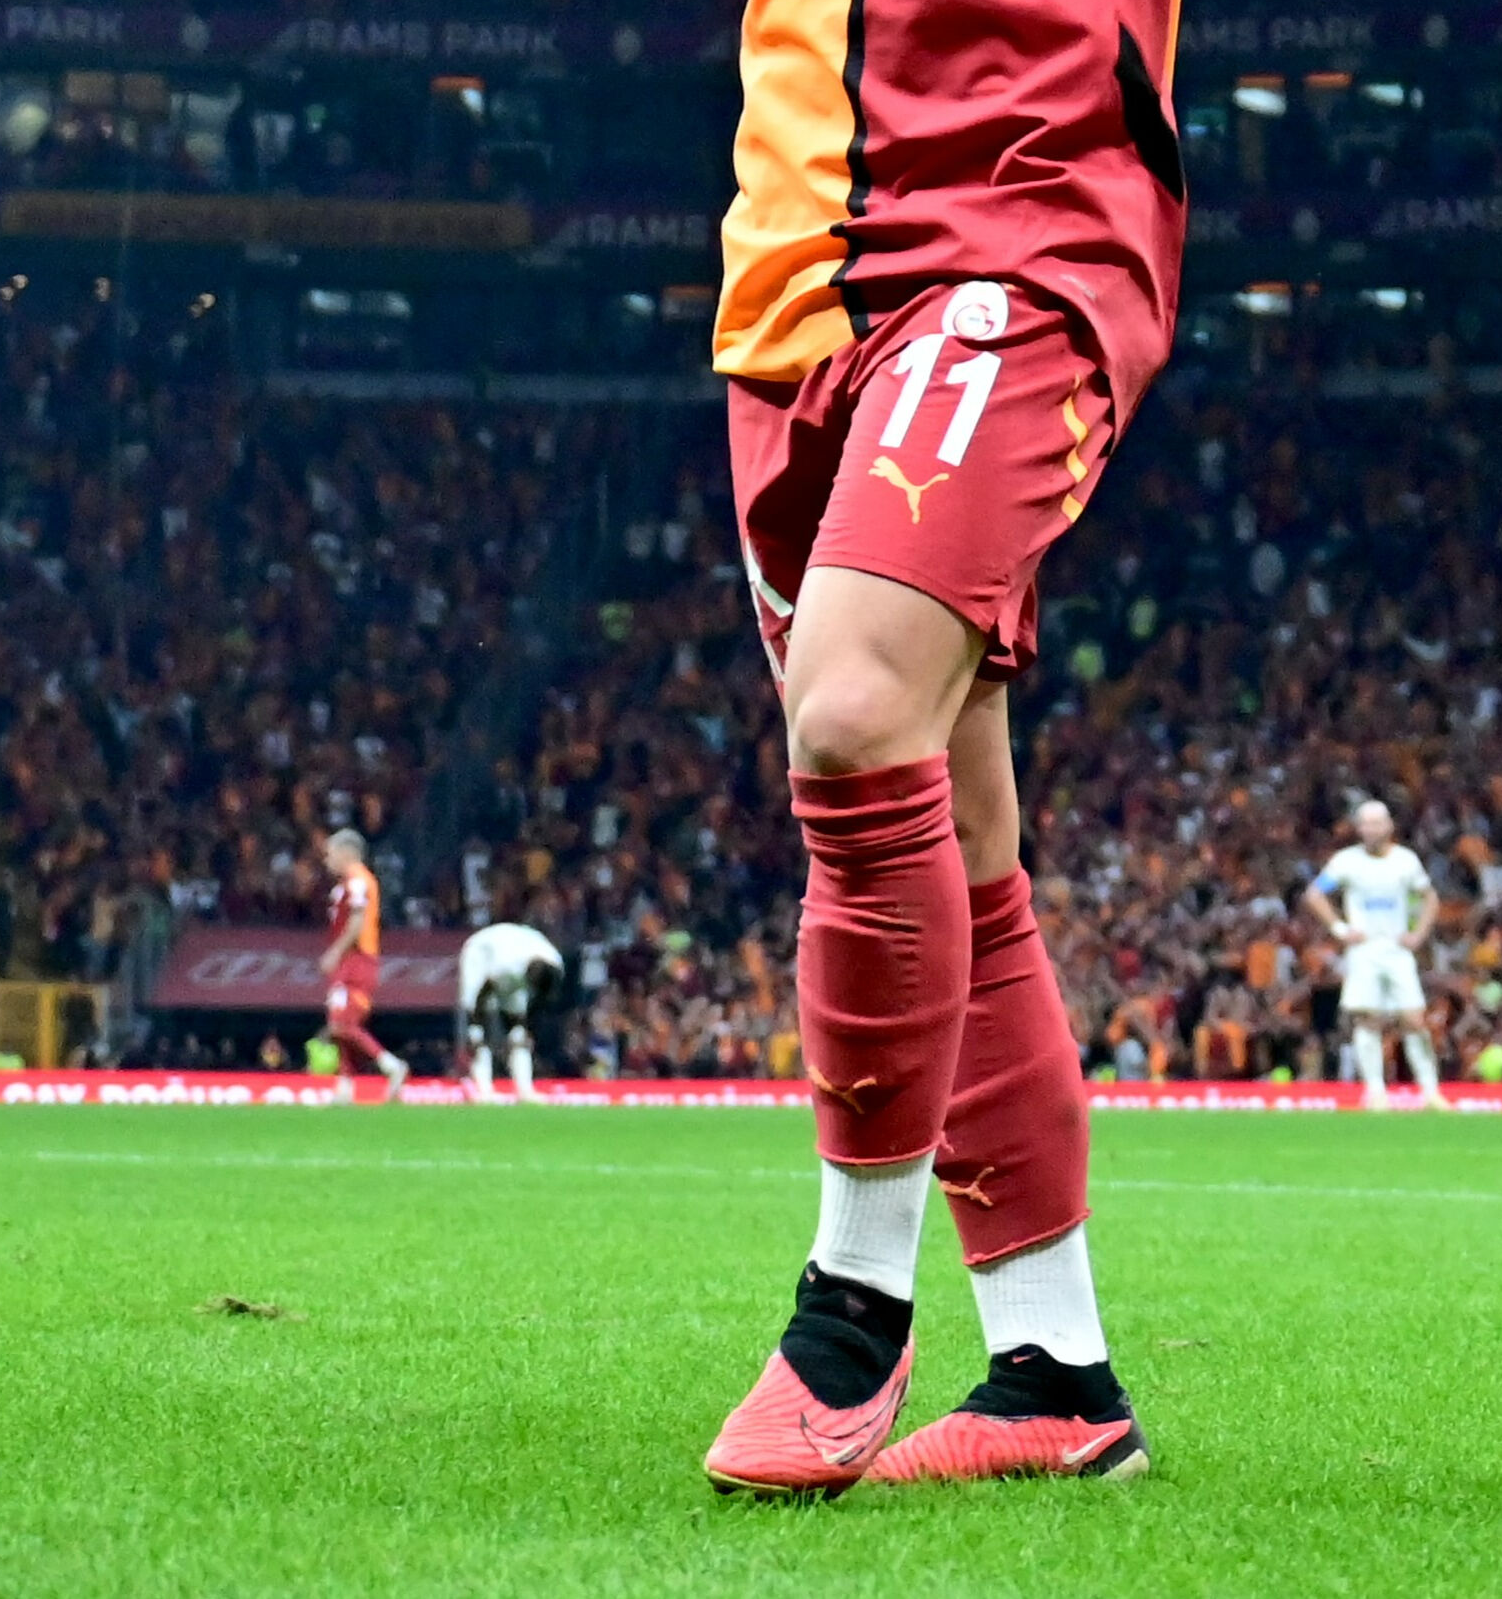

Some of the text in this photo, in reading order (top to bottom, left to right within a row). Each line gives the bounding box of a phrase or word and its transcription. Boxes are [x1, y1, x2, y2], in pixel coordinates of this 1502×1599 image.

[7, 5, 122, 41] PARK
[307, 18, 555, 59] RAMS PARK
[1181, 14, 1258, 51] AMS
[878, 333, 1002, 467] 11
